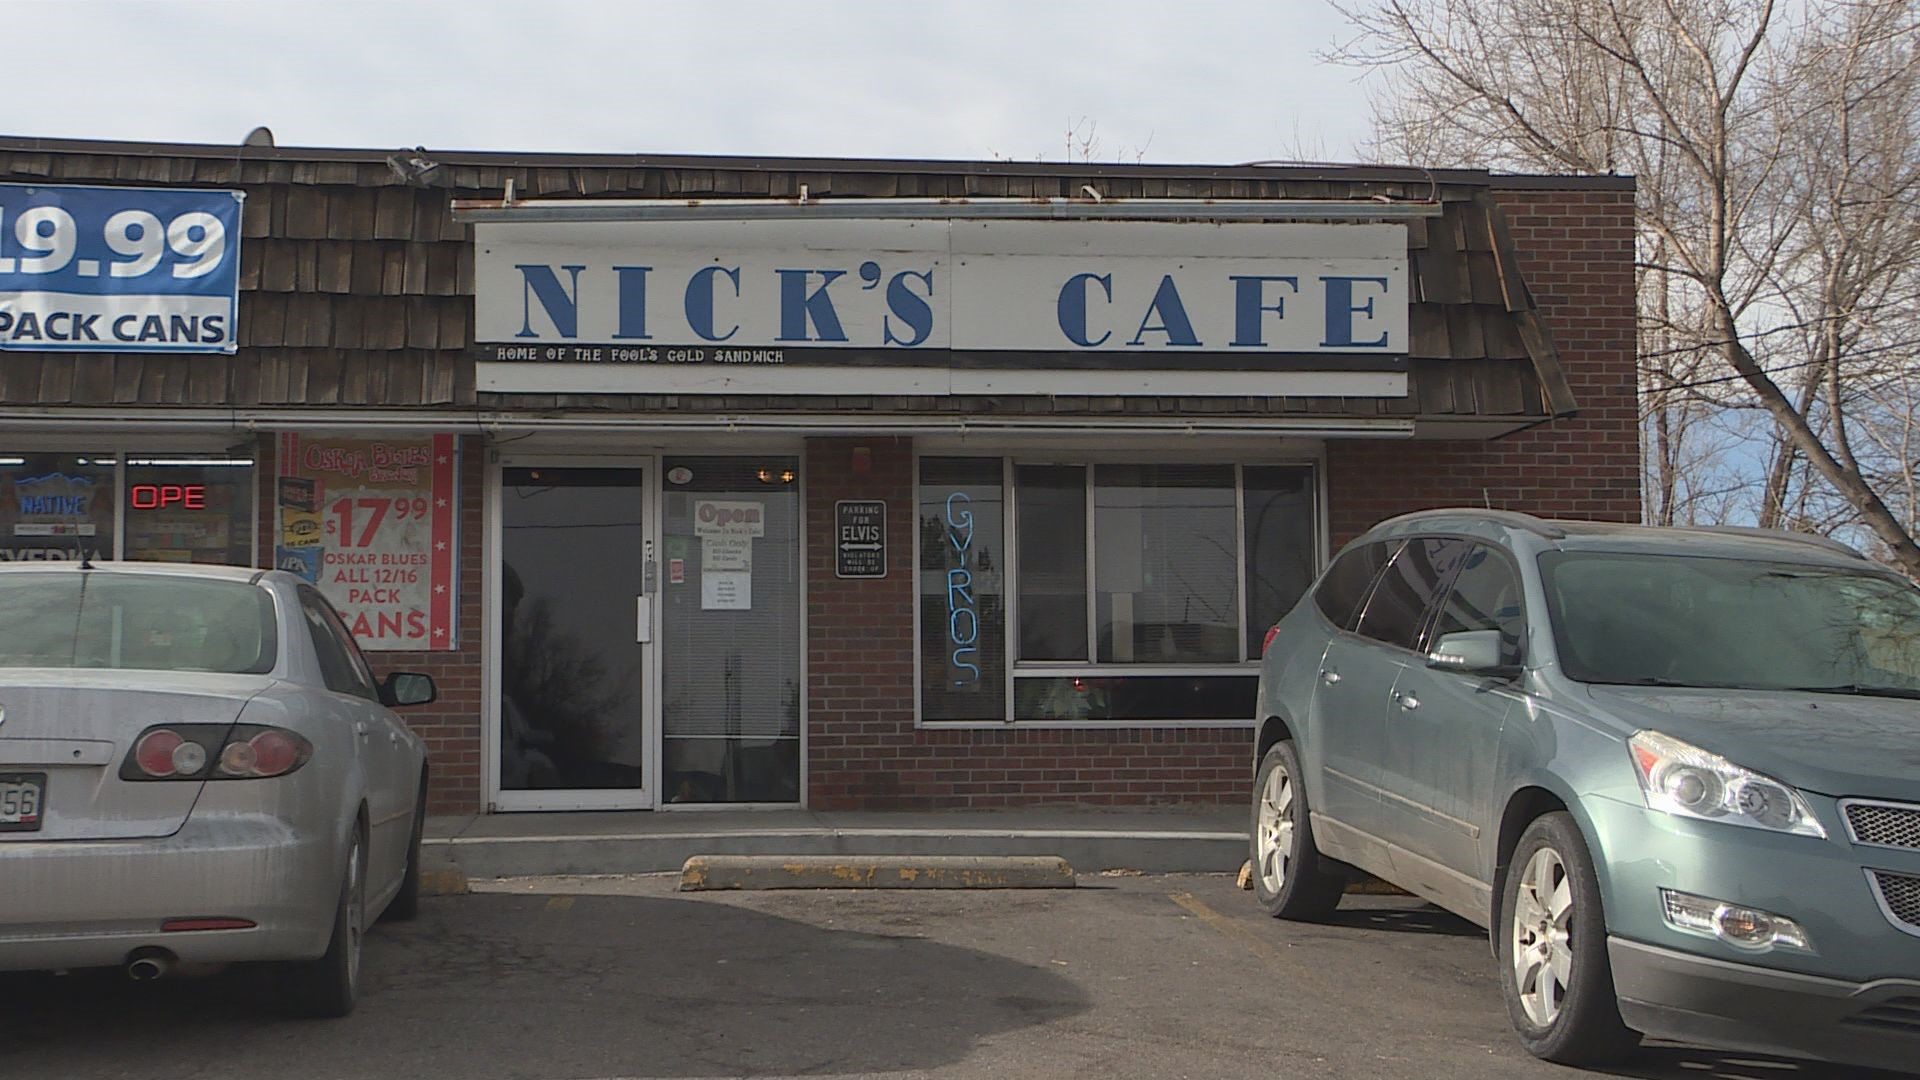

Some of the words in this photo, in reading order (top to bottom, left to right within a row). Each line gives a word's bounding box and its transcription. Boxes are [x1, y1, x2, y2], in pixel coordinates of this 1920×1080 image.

[514, 261, 934, 346] NICK'S
[1057, 272, 1388, 348] CAFE
[112, 315, 225, 343] CANS
[497, 347, 536, 360] HOME
[546, 347, 566, 361] OF
[574, 348, 601, 361] THE
[611, 347, 658, 362] FOOL'S
[667, 350, 704, 362] GOLD
[714, 350, 784, 363] SANDWICH
[20, 495, 87, 515] NATIVE
[842, 506, 879, 514] PARKING
[698, 503, 760, 527] Open
[853, 516, 869, 524] FOR
[842, 526, 880, 541] ELVIS
[281, 556, 308, 575] IPA
[325, 553, 377, 565] OSKAR
[382, 554, 428, 565] BLUES
[334, 568, 369, 583] ALL
[374, 569, 418, 583] 12/16
[349, 589, 401, 604] PACK
[946, 492, 979, 686] GYROS
[336, 610, 426, 639] ANS
[0, 790, 34, 815] 56
